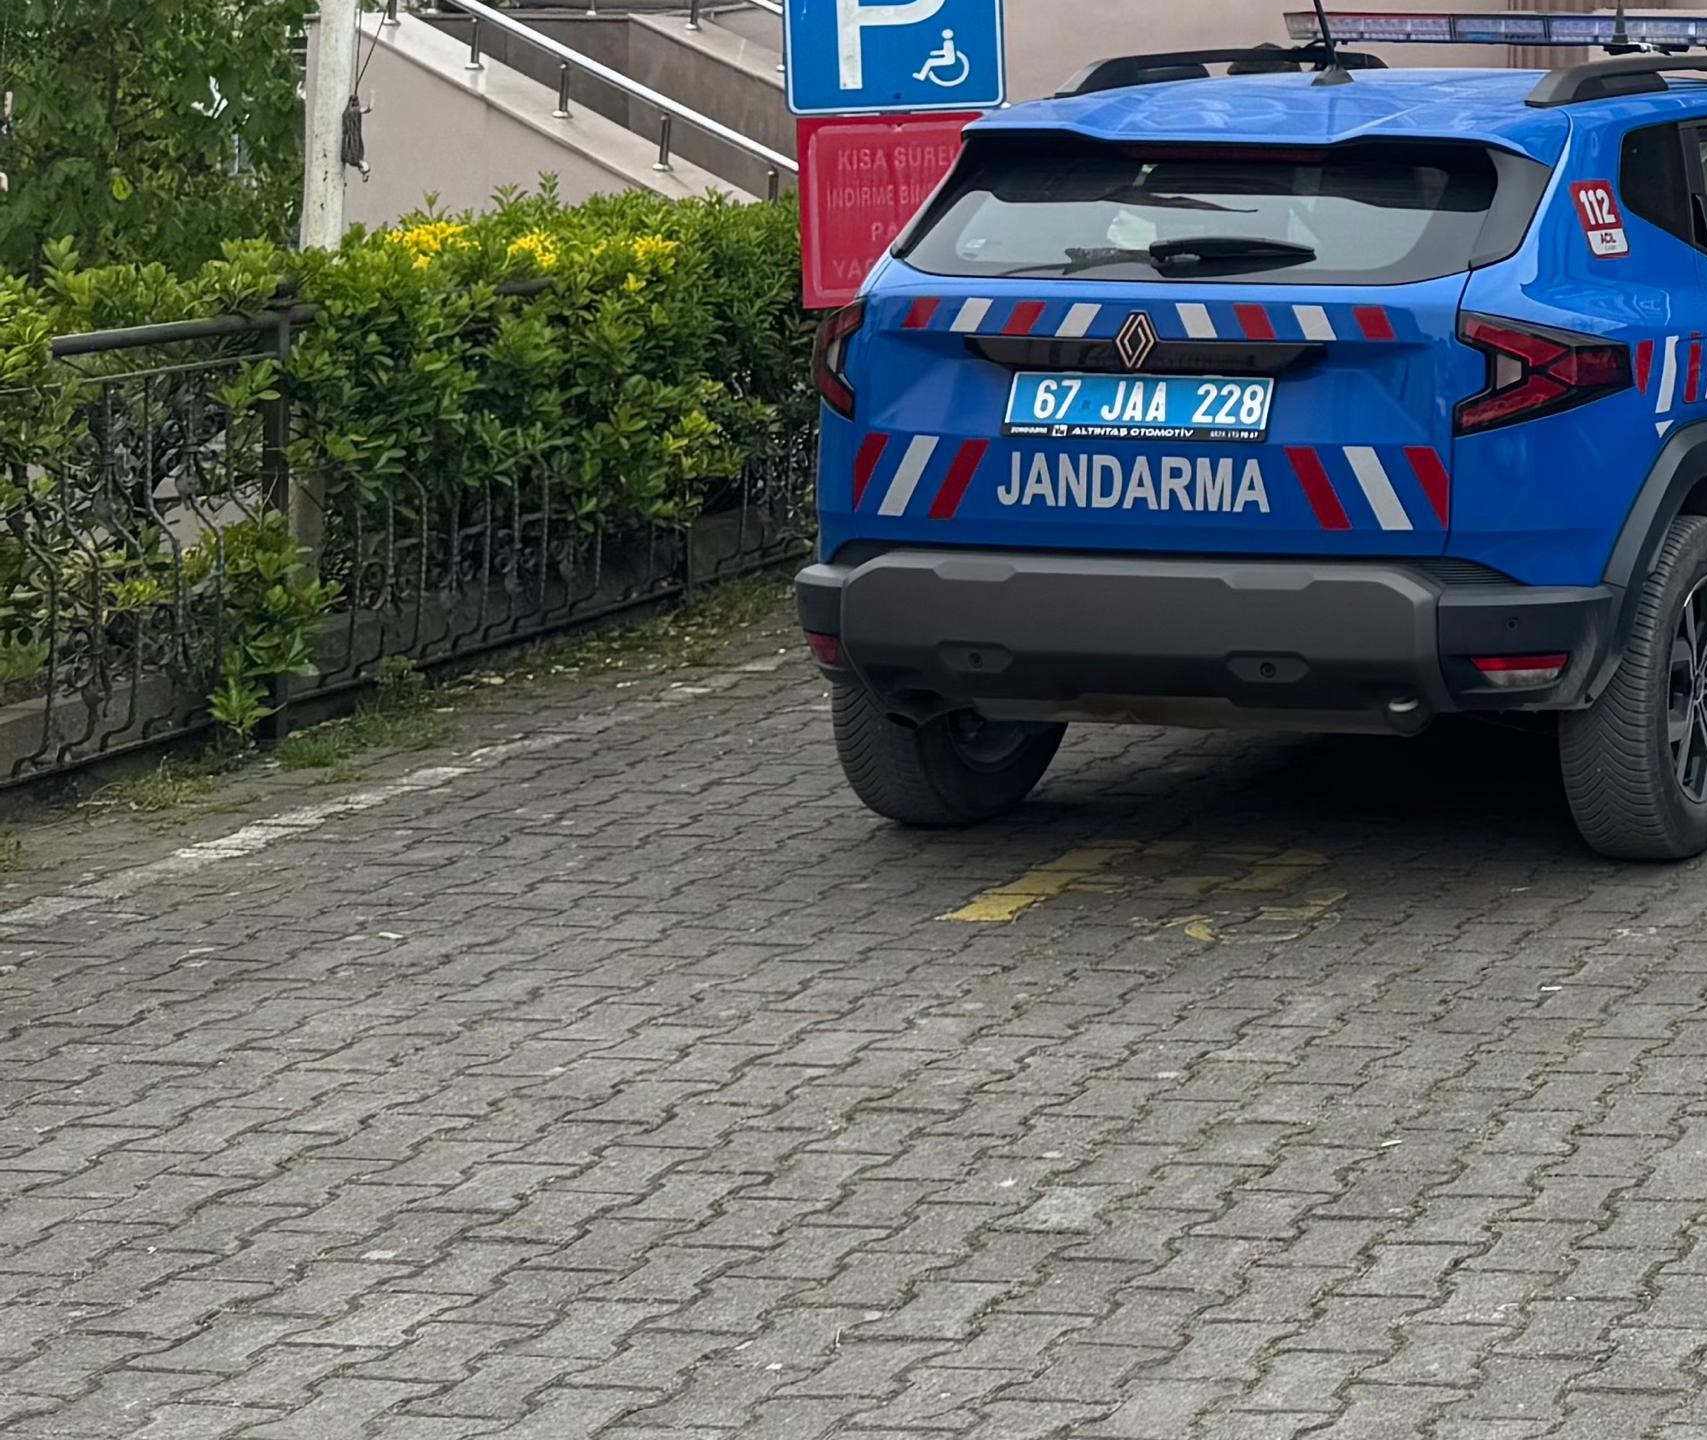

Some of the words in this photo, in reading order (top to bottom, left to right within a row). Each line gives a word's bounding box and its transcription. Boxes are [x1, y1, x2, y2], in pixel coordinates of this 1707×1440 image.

[838, 148, 888, 171] KISA
[1579, 188, 1616, 226] 112
[1033, 379, 1082, 420] 67
[1101, 381, 1167, 422] JAA
[1191, 383, 1264, 425] 228
[1130, 427, 1194, 438] OTOMOTİV
[997, 451, 1270, 513] JANDARMA
